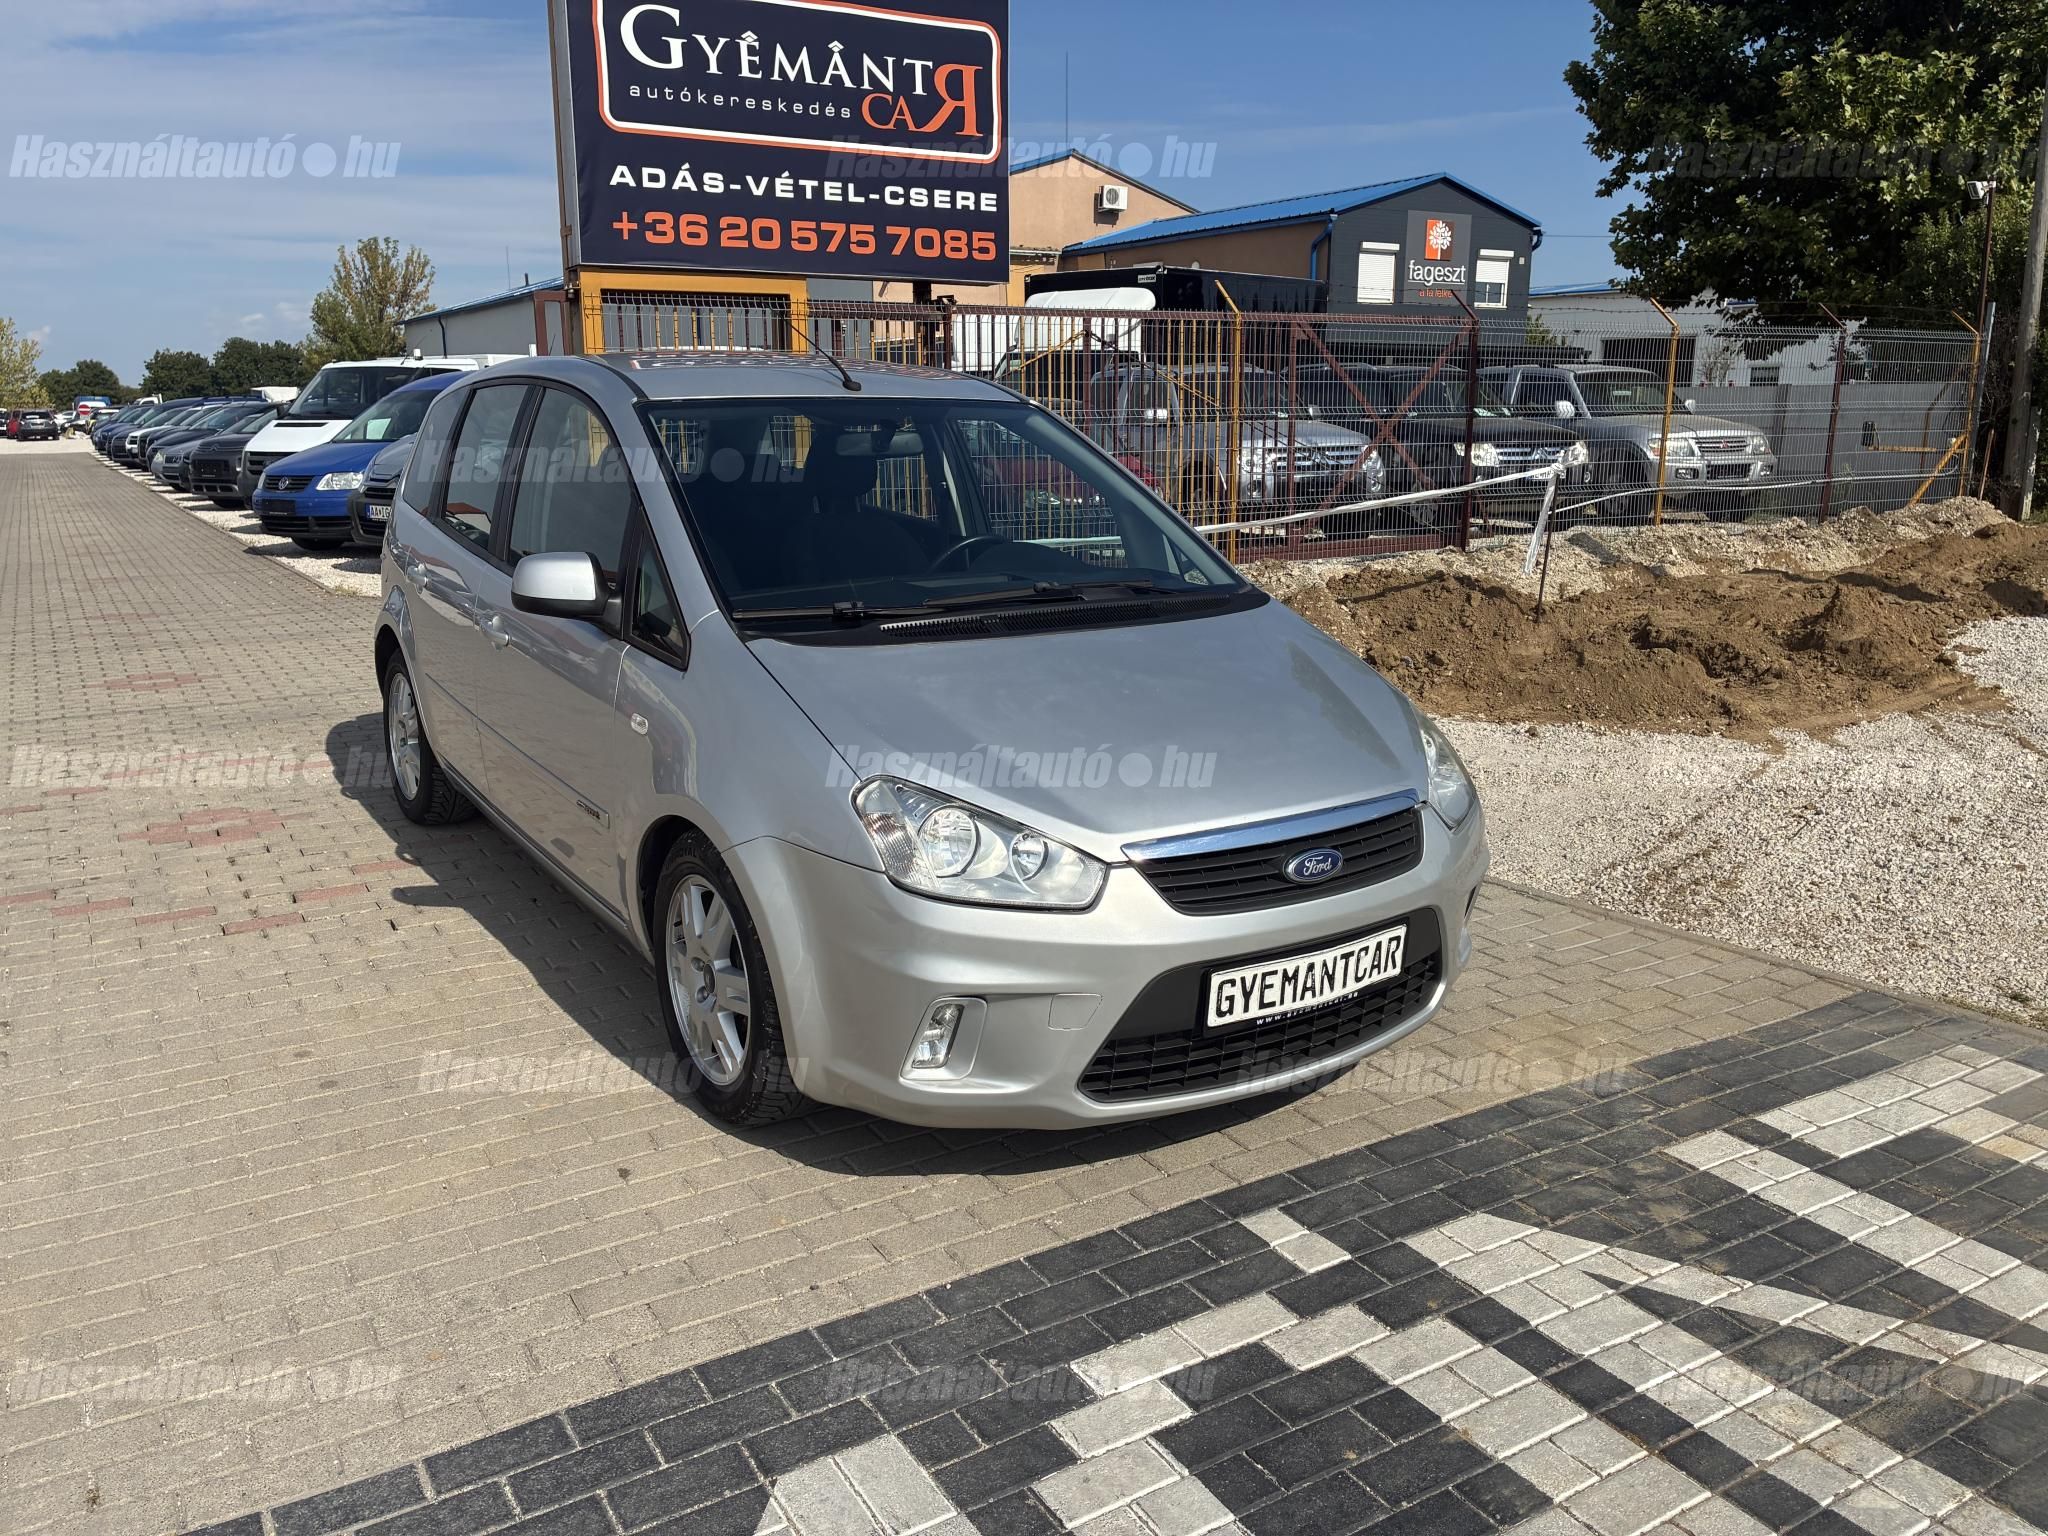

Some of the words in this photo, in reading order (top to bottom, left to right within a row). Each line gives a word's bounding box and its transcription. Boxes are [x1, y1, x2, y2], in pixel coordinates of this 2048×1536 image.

[629, 83, 851, 119] autókereskedés
[609, 162, 998, 212] ADÁS-VÉTEL-CSERE
[612, 211, 709, 247] +36
[720, 216, 781, 249] 20
[791, 221, 876, 255] 575
[886, 226, 997, 261] 7085
[1408, 260, 1466, 286] fageszt
[1303, 855, 1333, 876] Ford
[1215, 934, 1402, 1018] GYEMANTCAR
